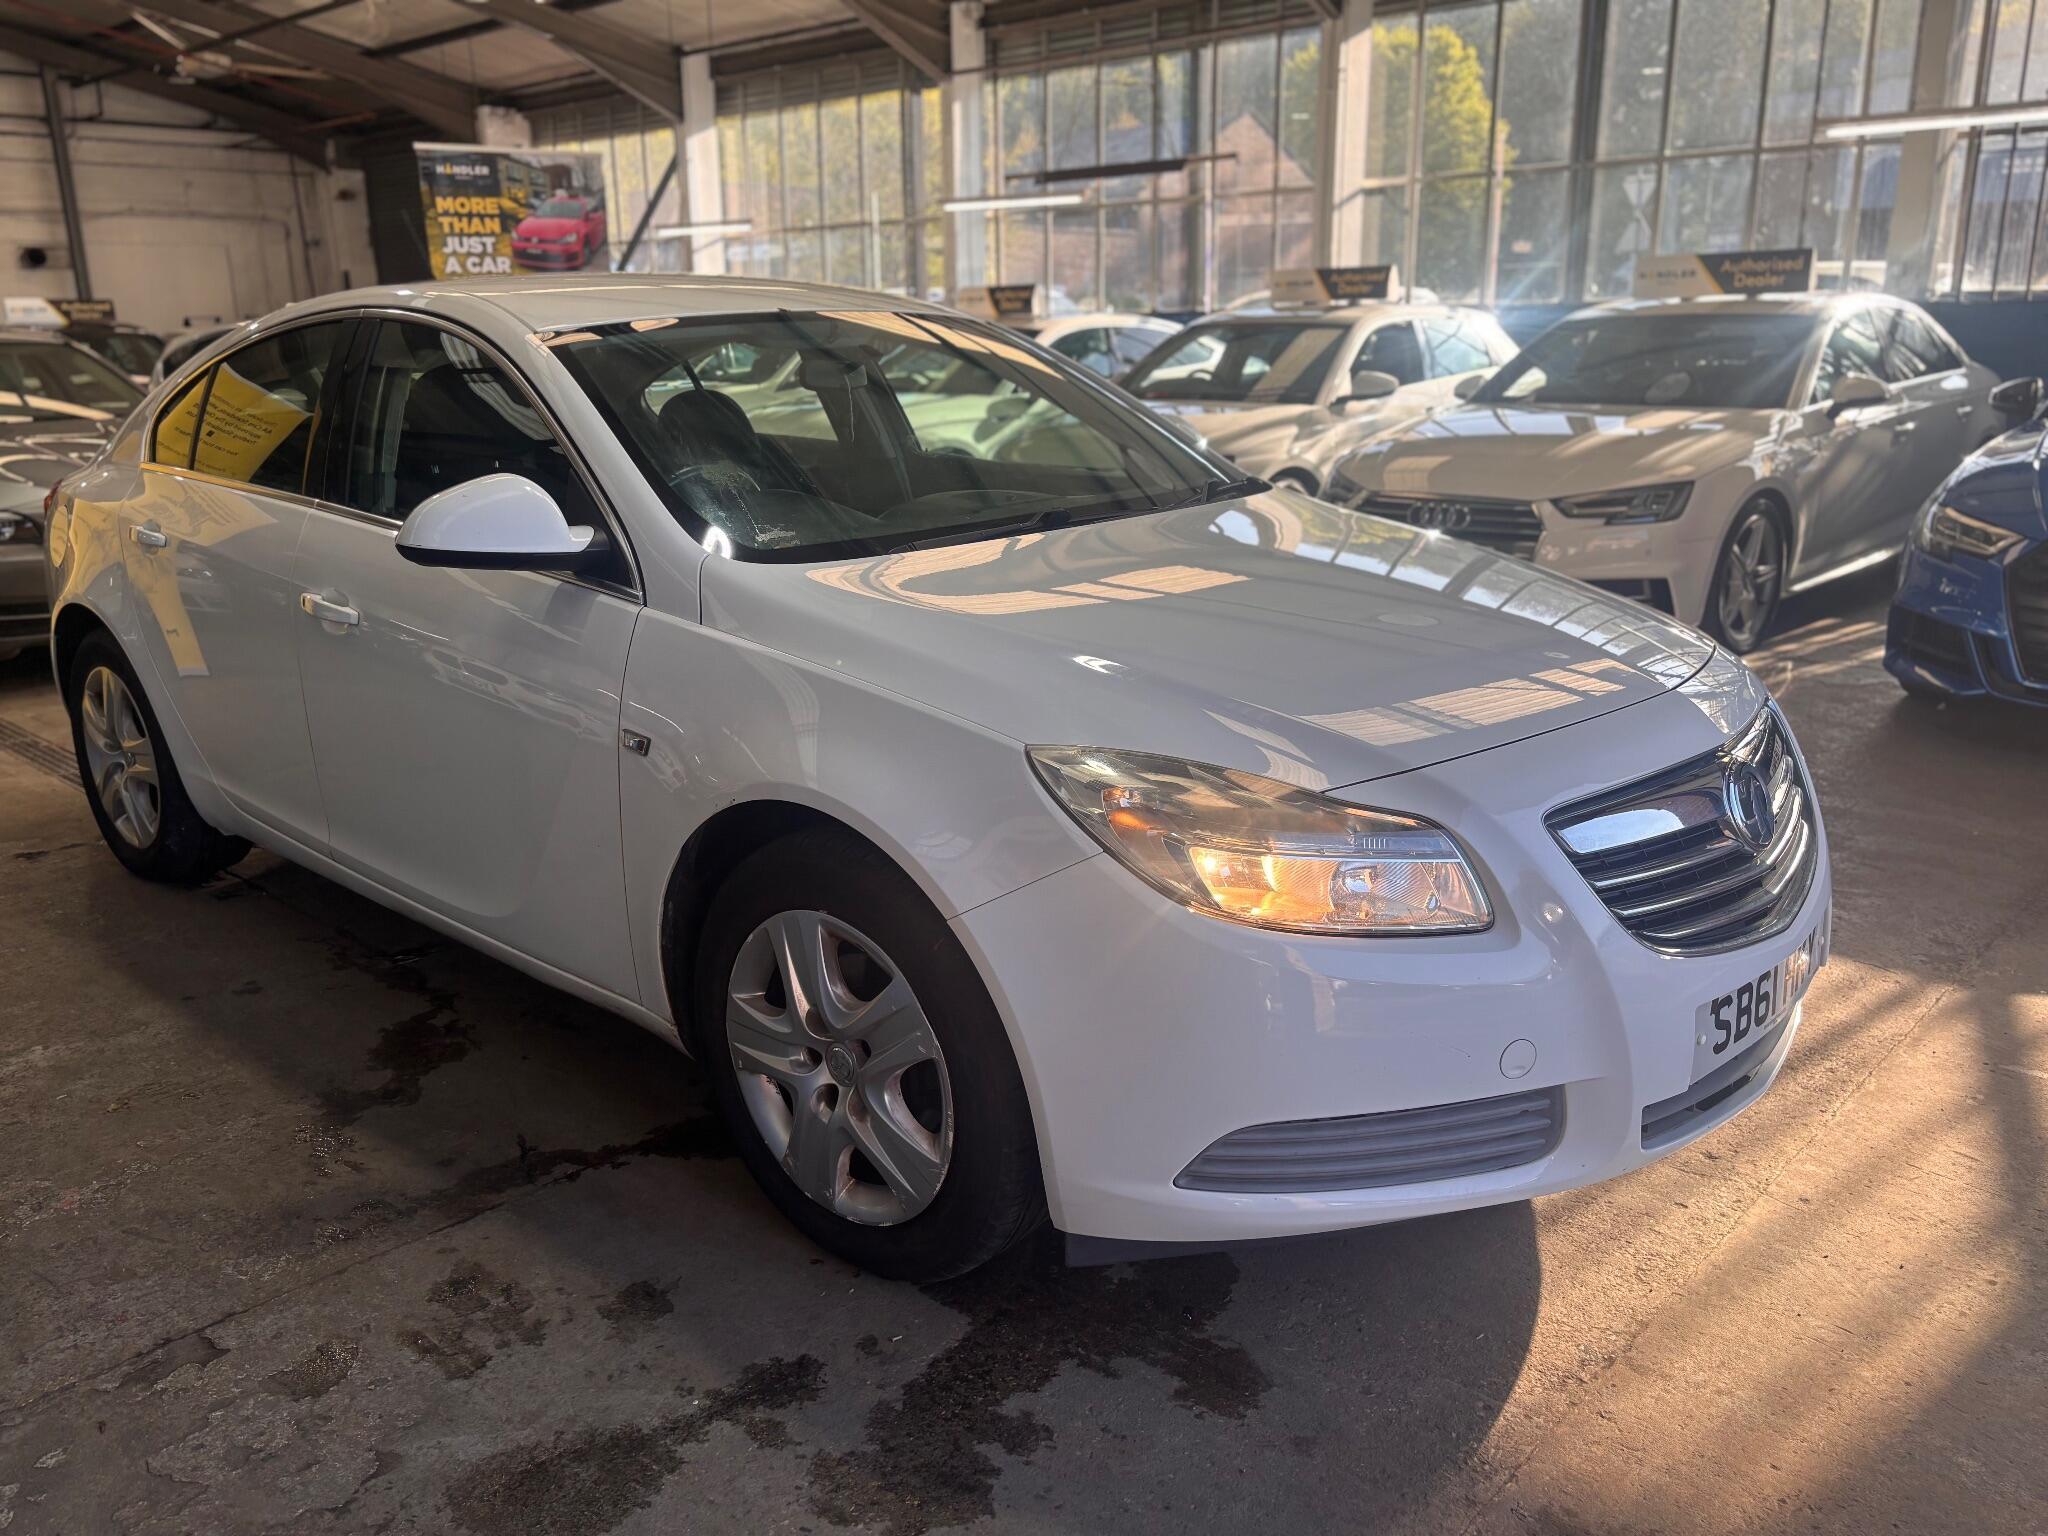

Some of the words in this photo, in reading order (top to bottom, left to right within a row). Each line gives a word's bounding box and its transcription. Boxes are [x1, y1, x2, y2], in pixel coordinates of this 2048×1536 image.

[436, 196, 500, 214] MORE
[438, 216, 501, 234] THAN
[443, 236, 496, 253] JUST
[444, 255, 462, 273] A
[466, 255, 512, 273] CAR
[1720, 254, 1805, 273] Authorised
[1733, 272, 1786, 288] Dealer
[1710, 965, 1779, 1055] SB61
